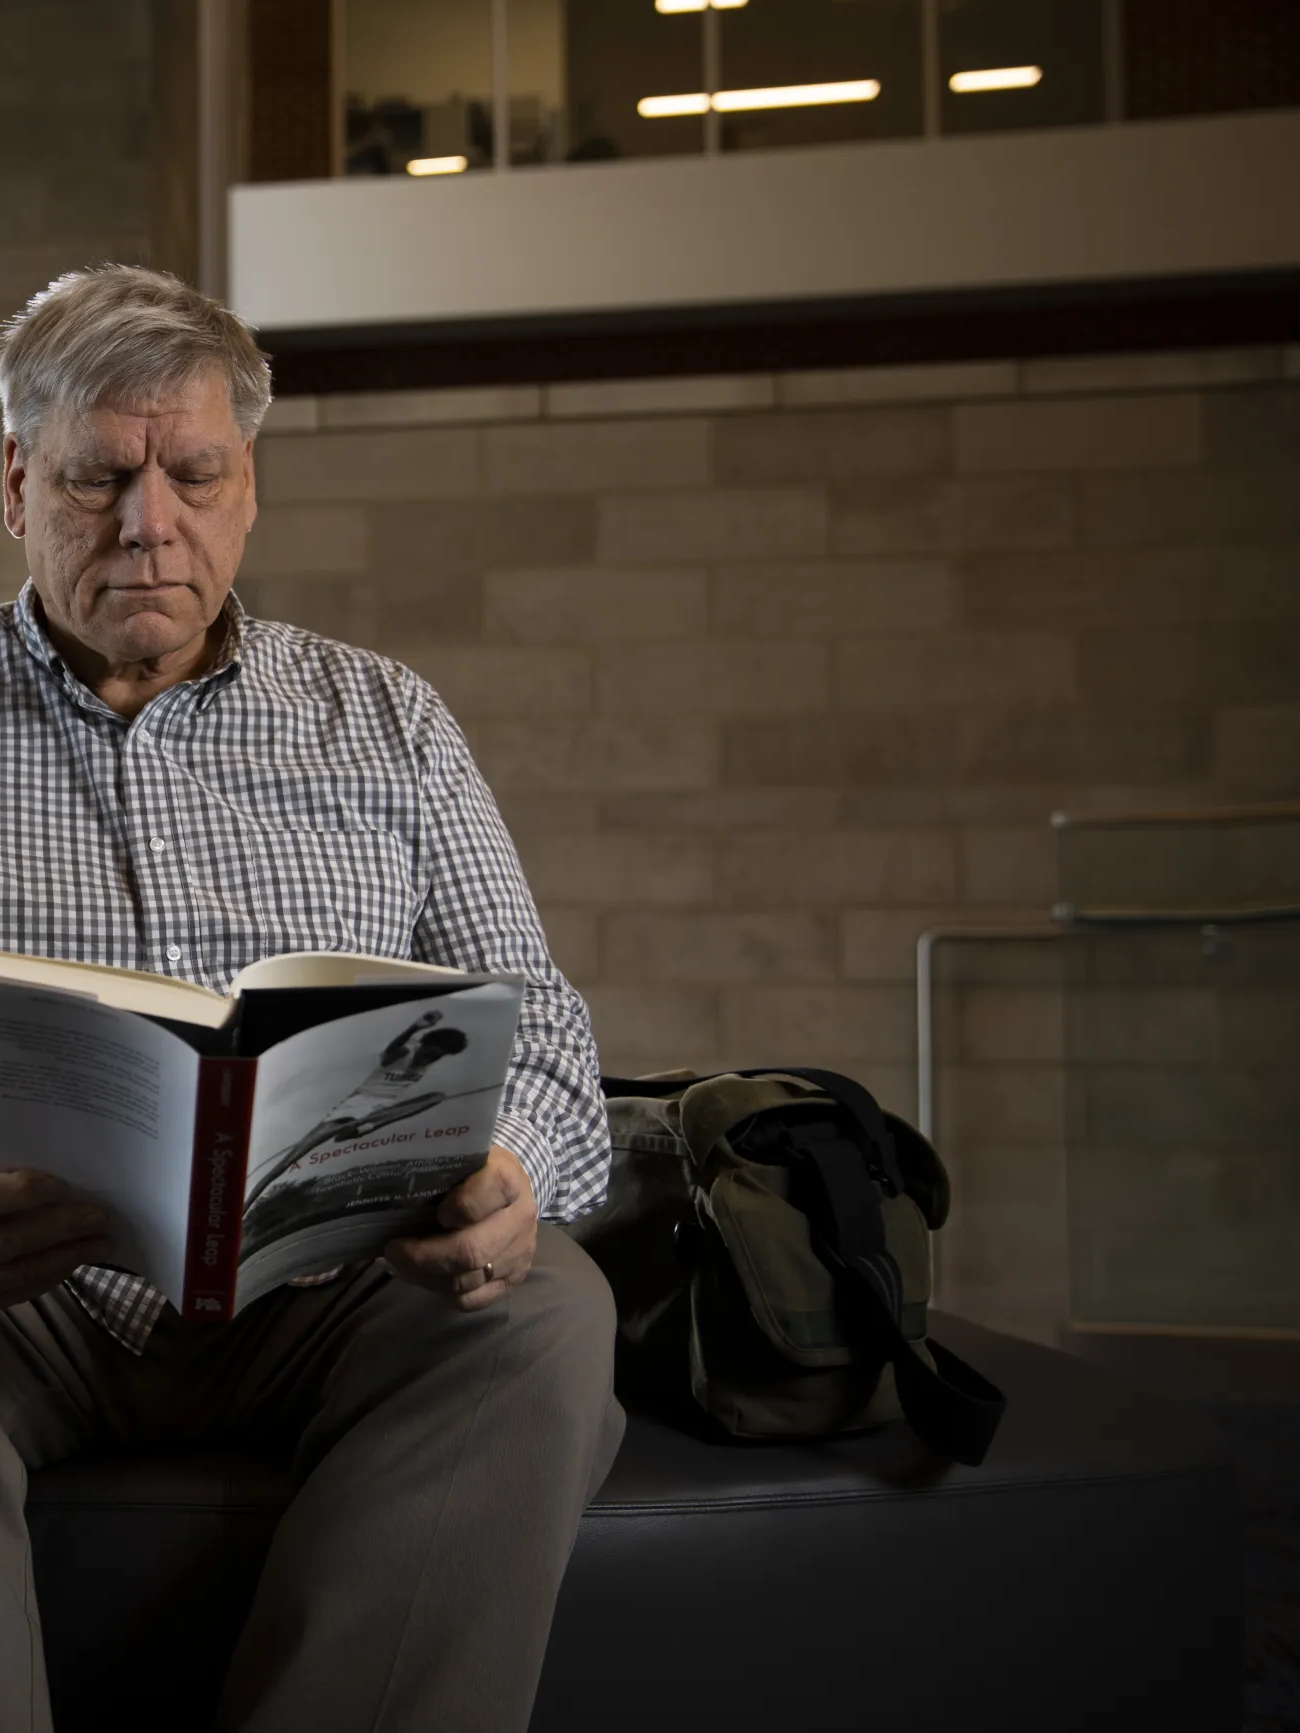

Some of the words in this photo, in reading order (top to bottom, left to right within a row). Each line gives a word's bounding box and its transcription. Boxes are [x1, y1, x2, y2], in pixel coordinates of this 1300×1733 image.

[214, 1131, 234, 1143] A
[288, 1162, 301, 1173] A
[309, 1131, 416, 1165] Spectacular
[424, 1125, 470, 1140] Leap
[359, 1162, 401, 1175] Women
[207, 1148, 235, 1228] Spectacular
[345, 1195, 390, 1208] JENNIFER
[200, 1233, 226, 1266] Leap
